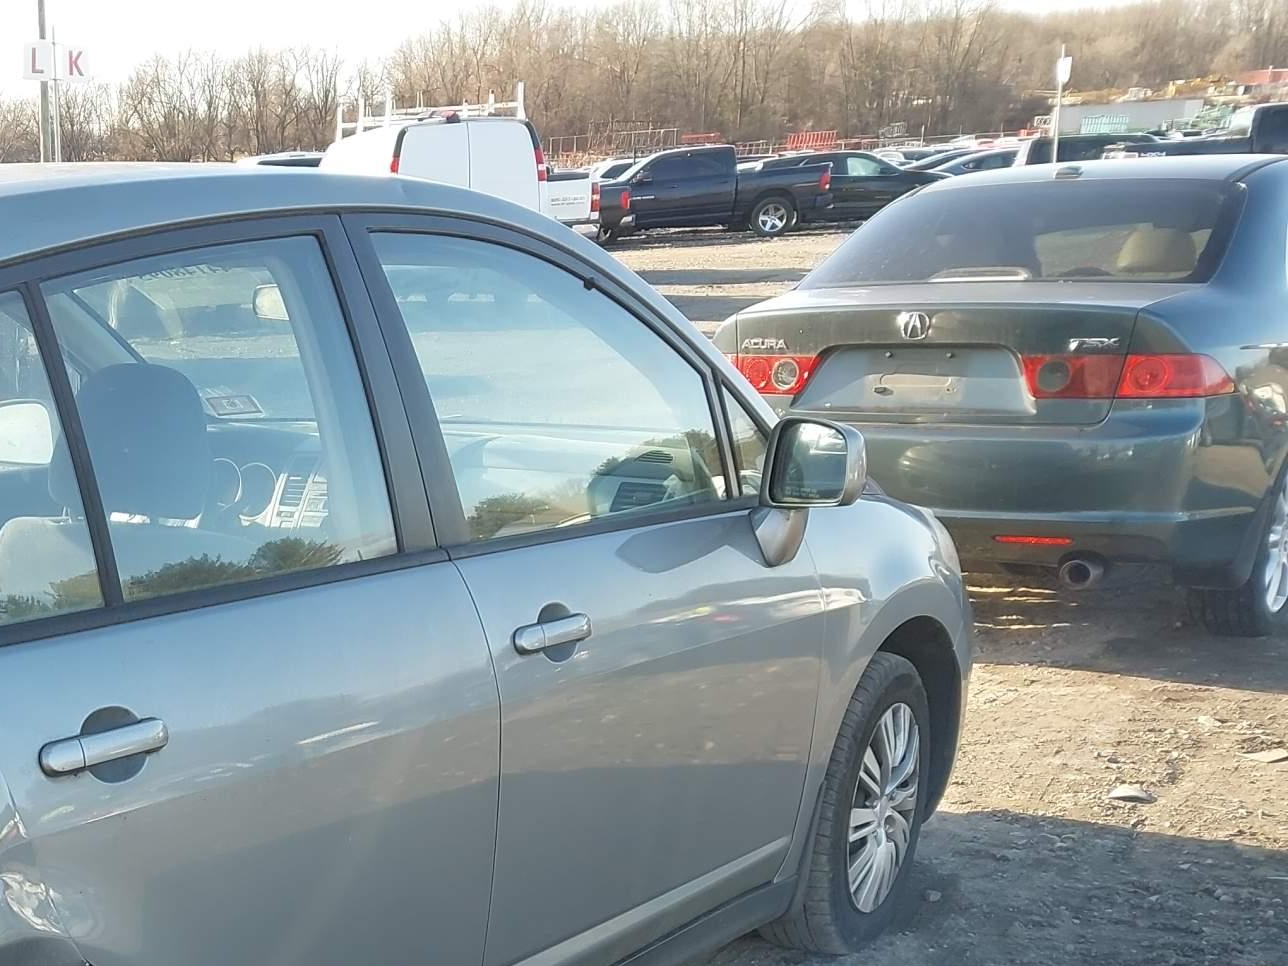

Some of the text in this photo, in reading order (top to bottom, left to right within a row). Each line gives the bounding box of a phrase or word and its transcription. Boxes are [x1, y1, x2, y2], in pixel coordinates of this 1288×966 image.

[31, 47, 45, 74] L
[68, 50, 85, 77] K
[741, 338, 789, 350] ACURA
[1068, 337, 1120, 351] TSX
